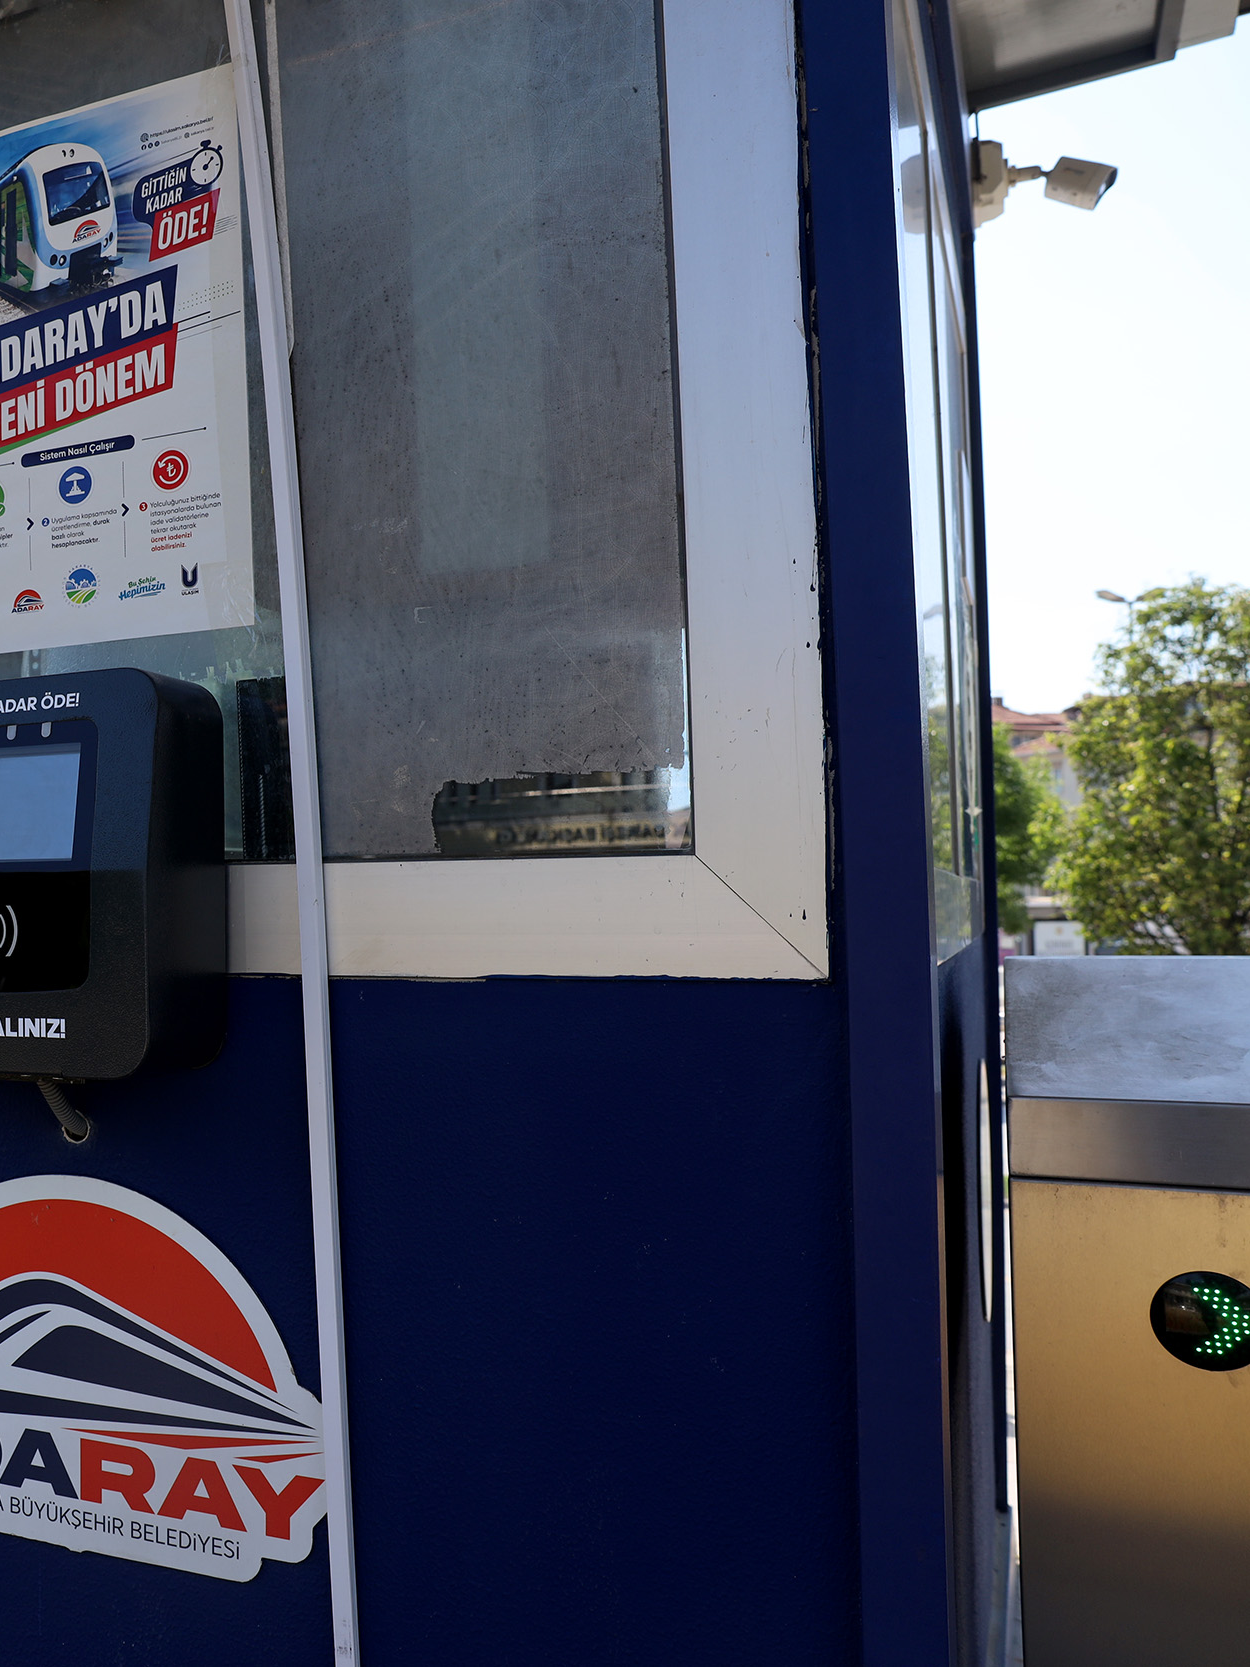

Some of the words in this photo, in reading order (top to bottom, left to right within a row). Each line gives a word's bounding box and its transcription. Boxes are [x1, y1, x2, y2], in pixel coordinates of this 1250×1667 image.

[141, 166, 187, 198] GİTTİĞİN
[145, 187, 183, 215] KADAR
[157, 201, 210, 250] ÖDE!
[72, 228, 102, 244] ADARAY
[55, 343, 166, 422] DÖNEM
[39, 450, 67, 461] Sistem
[68, 444, 88, 456] Nasıl
[89, 441, 116, 454] Çalışır
[150, 497, 189, 508] Yolculuğunuz
[190, 492, 221, 502] bittiğinde
[196, 501, 222, 510] bulunan
[51, 514, 81, 524] Uygulama
[81, 508, 117, 519] kapsamında
[92, 518, 110, 526] durak
[165, 512, 210, 524] validatörlerine
[66, 531, 85, 539] olarak
[169, 522, 197, 532] okutarak
[151, 535, 167, 543] ücret
[168, 531, 192, 541] iadenizi
[118, 581, 166, 601] Hepimizin
[11, 604, 45, 613] ADARAY
[40, 692, 80, 710] ÖDE!
